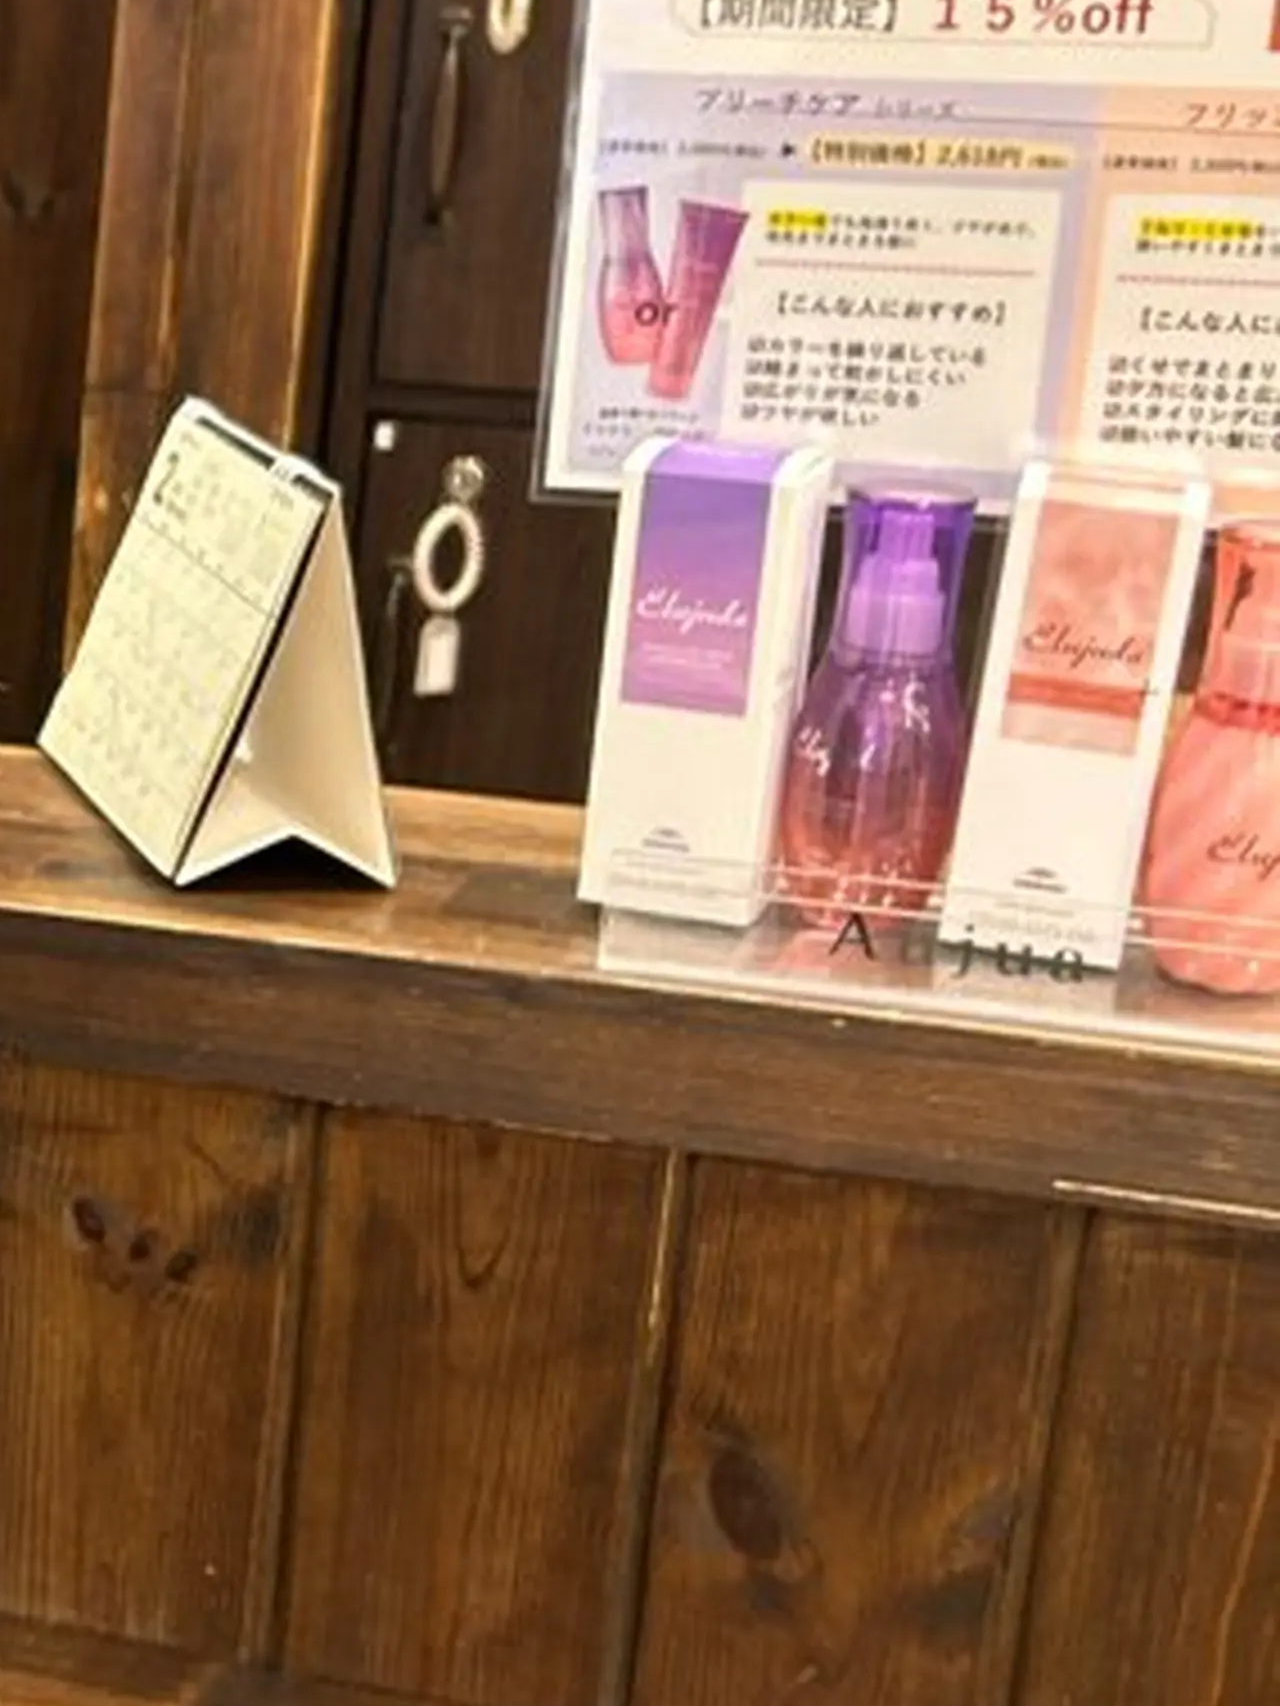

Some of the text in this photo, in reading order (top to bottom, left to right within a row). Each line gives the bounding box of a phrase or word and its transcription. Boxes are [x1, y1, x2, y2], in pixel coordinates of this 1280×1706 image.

[1186, 101, 1280, 128] フリッ
[634, 301, 680, 327] or
[1140, 306, 1280, 335] 【こんな人に
[1127, 379, 1280, 404] 夕方になると広
